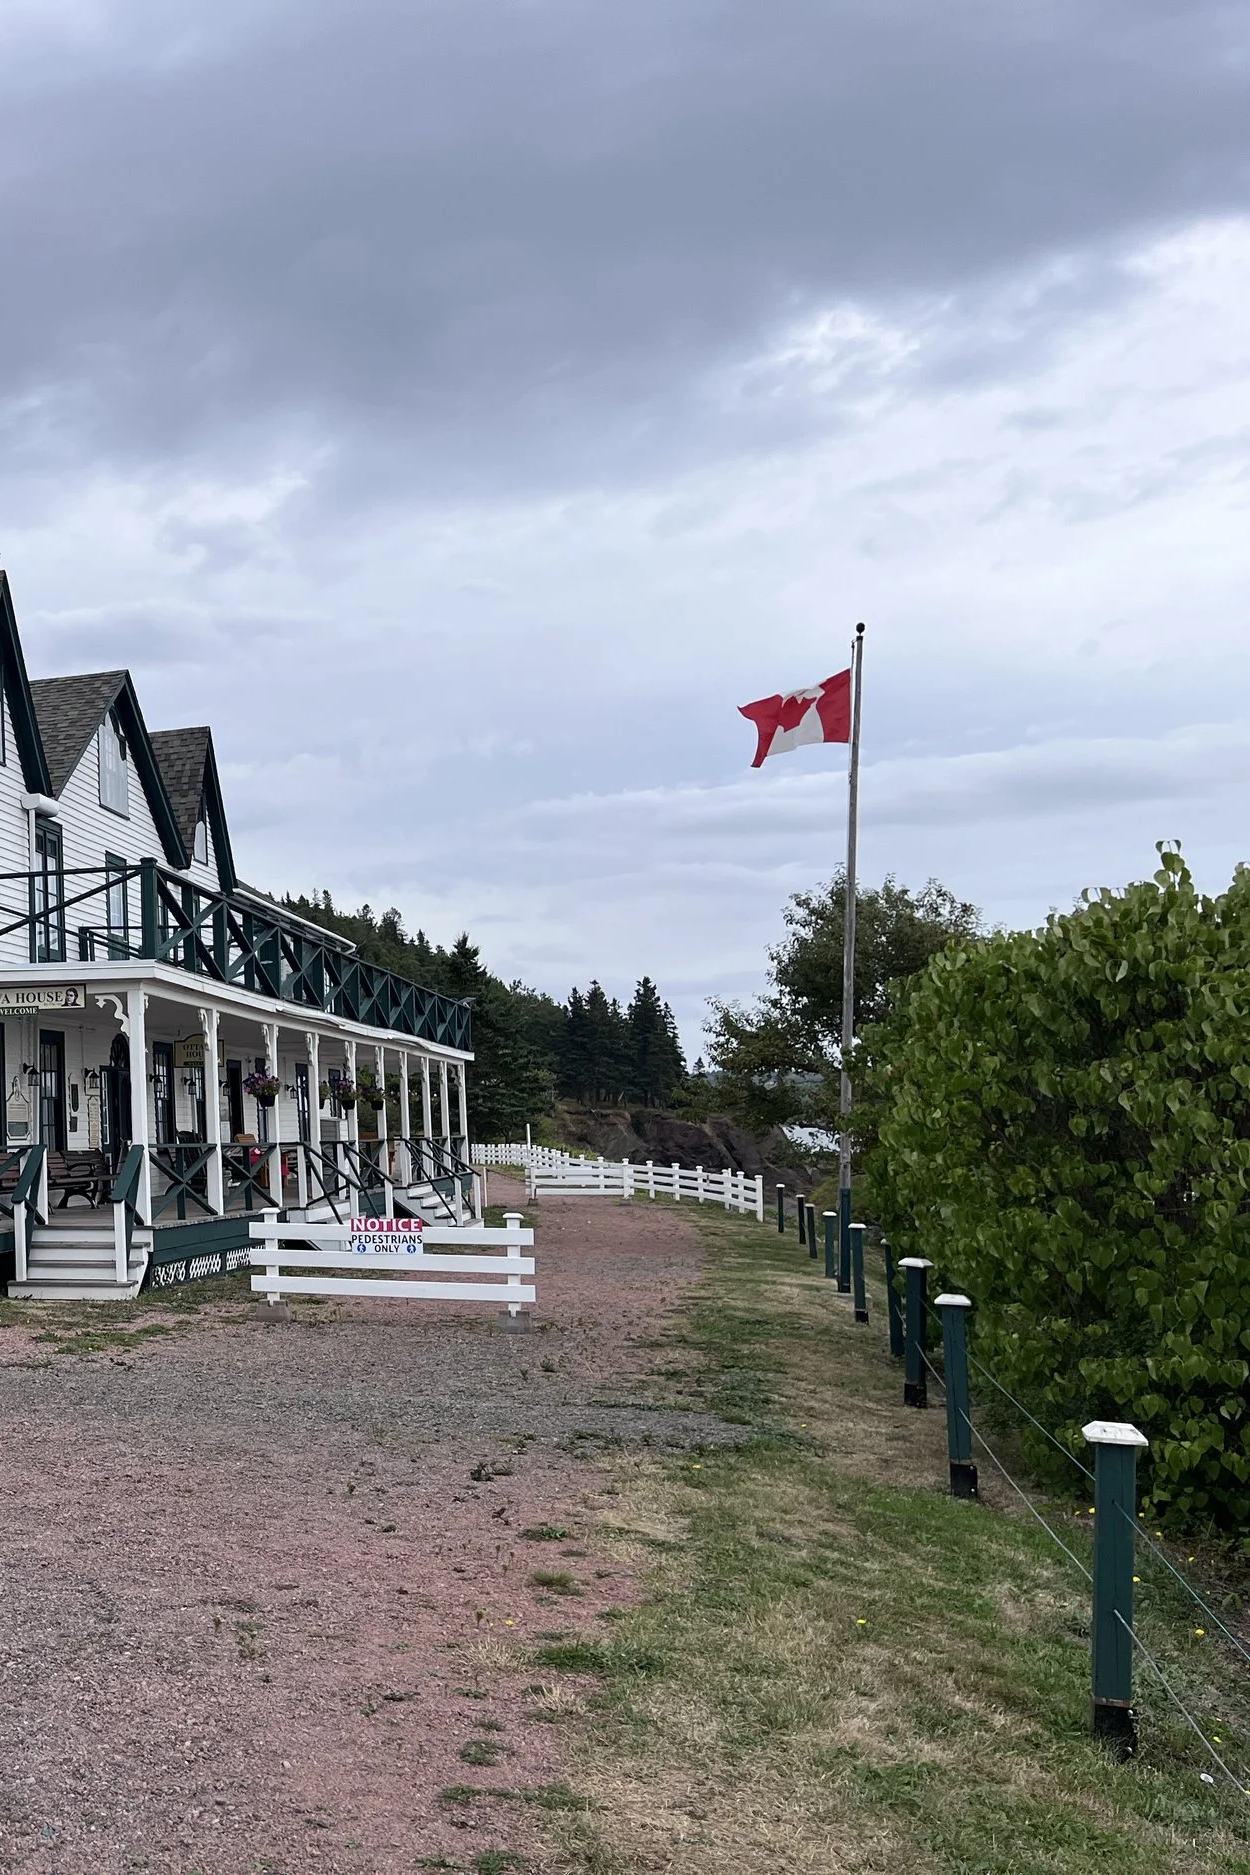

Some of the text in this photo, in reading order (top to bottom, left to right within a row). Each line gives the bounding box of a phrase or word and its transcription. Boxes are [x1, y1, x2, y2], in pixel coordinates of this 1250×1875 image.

[16, 991, 63, 1003] HOUSE
[353, 1218, 420, 1232] NOTICE
[351, 1234, 422, 1244] PEDESTRIANS
